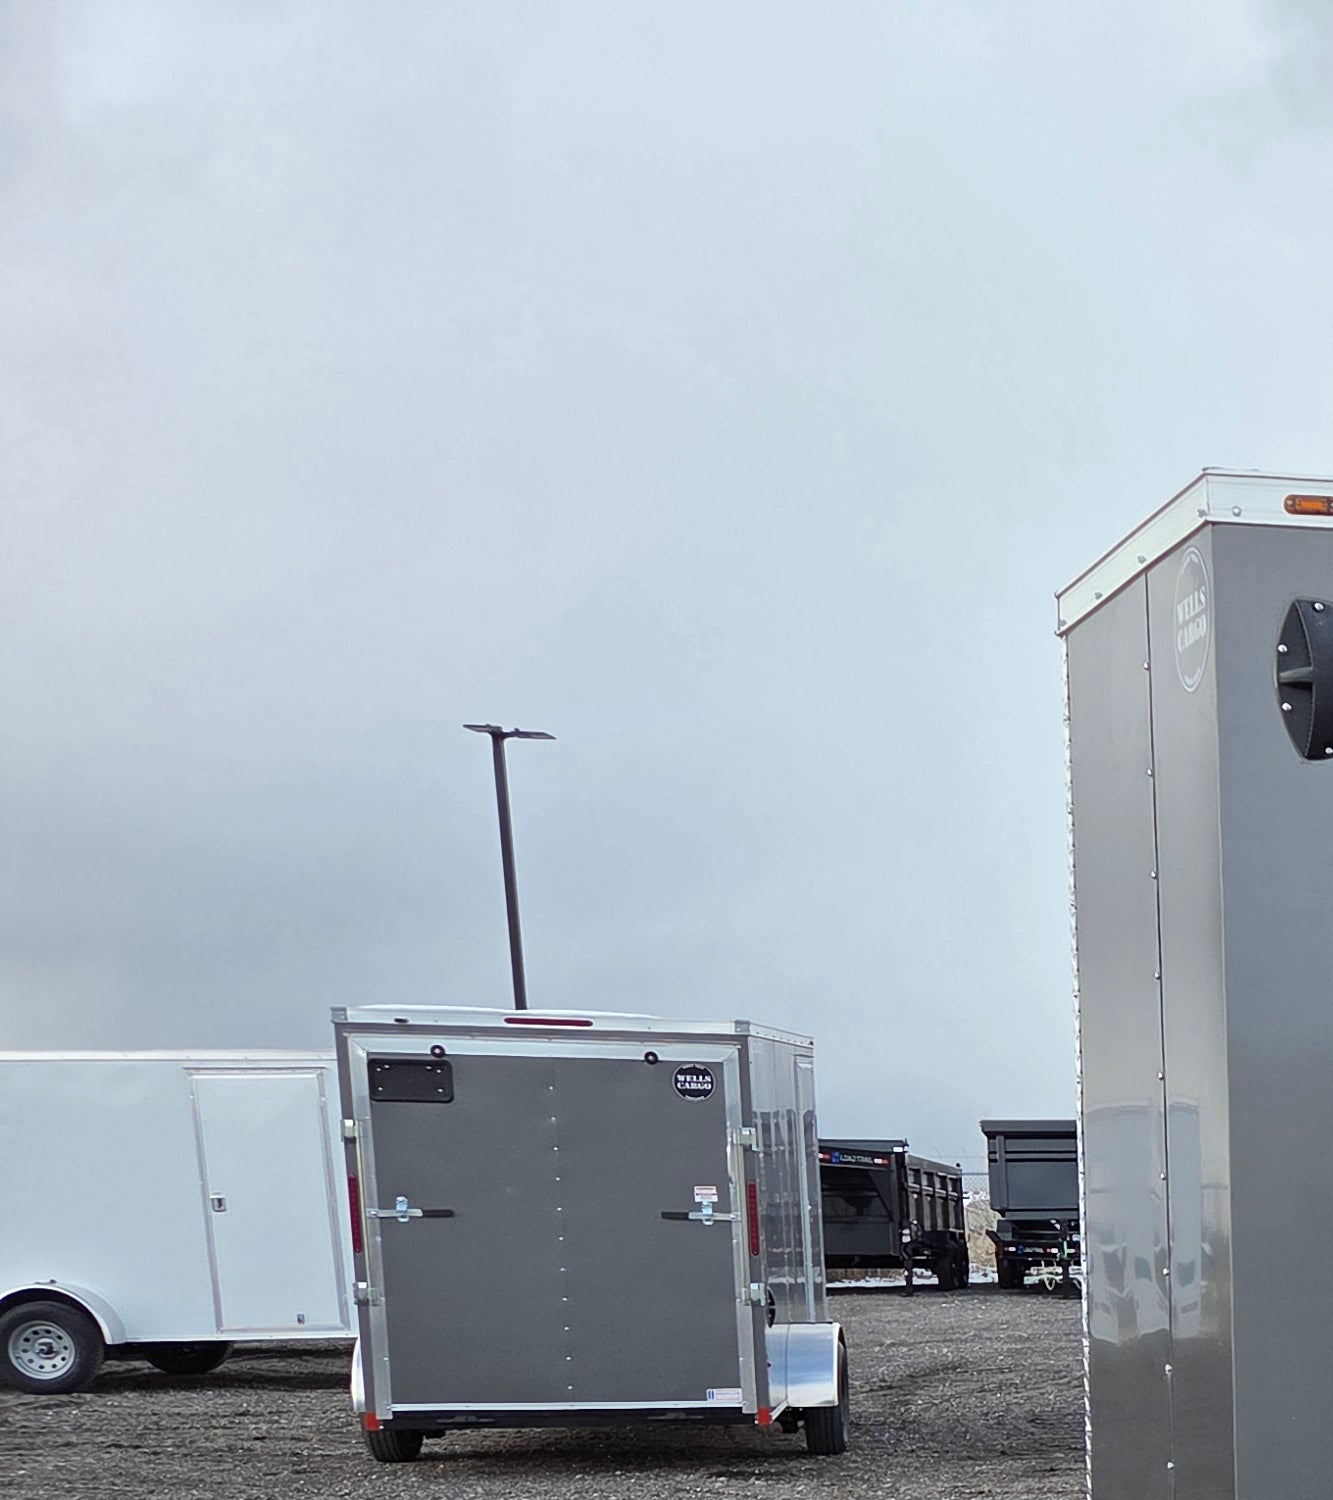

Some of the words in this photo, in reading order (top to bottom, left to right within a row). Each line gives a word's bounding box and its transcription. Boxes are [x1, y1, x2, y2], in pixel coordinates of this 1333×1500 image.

[1177, 586, 1206, 625] WELLS
[1177, 614, 1207, 653] CARGO
[676, 1074, 712, 1082] WELLS
[676, 1082, 712, 1090] CARGO
